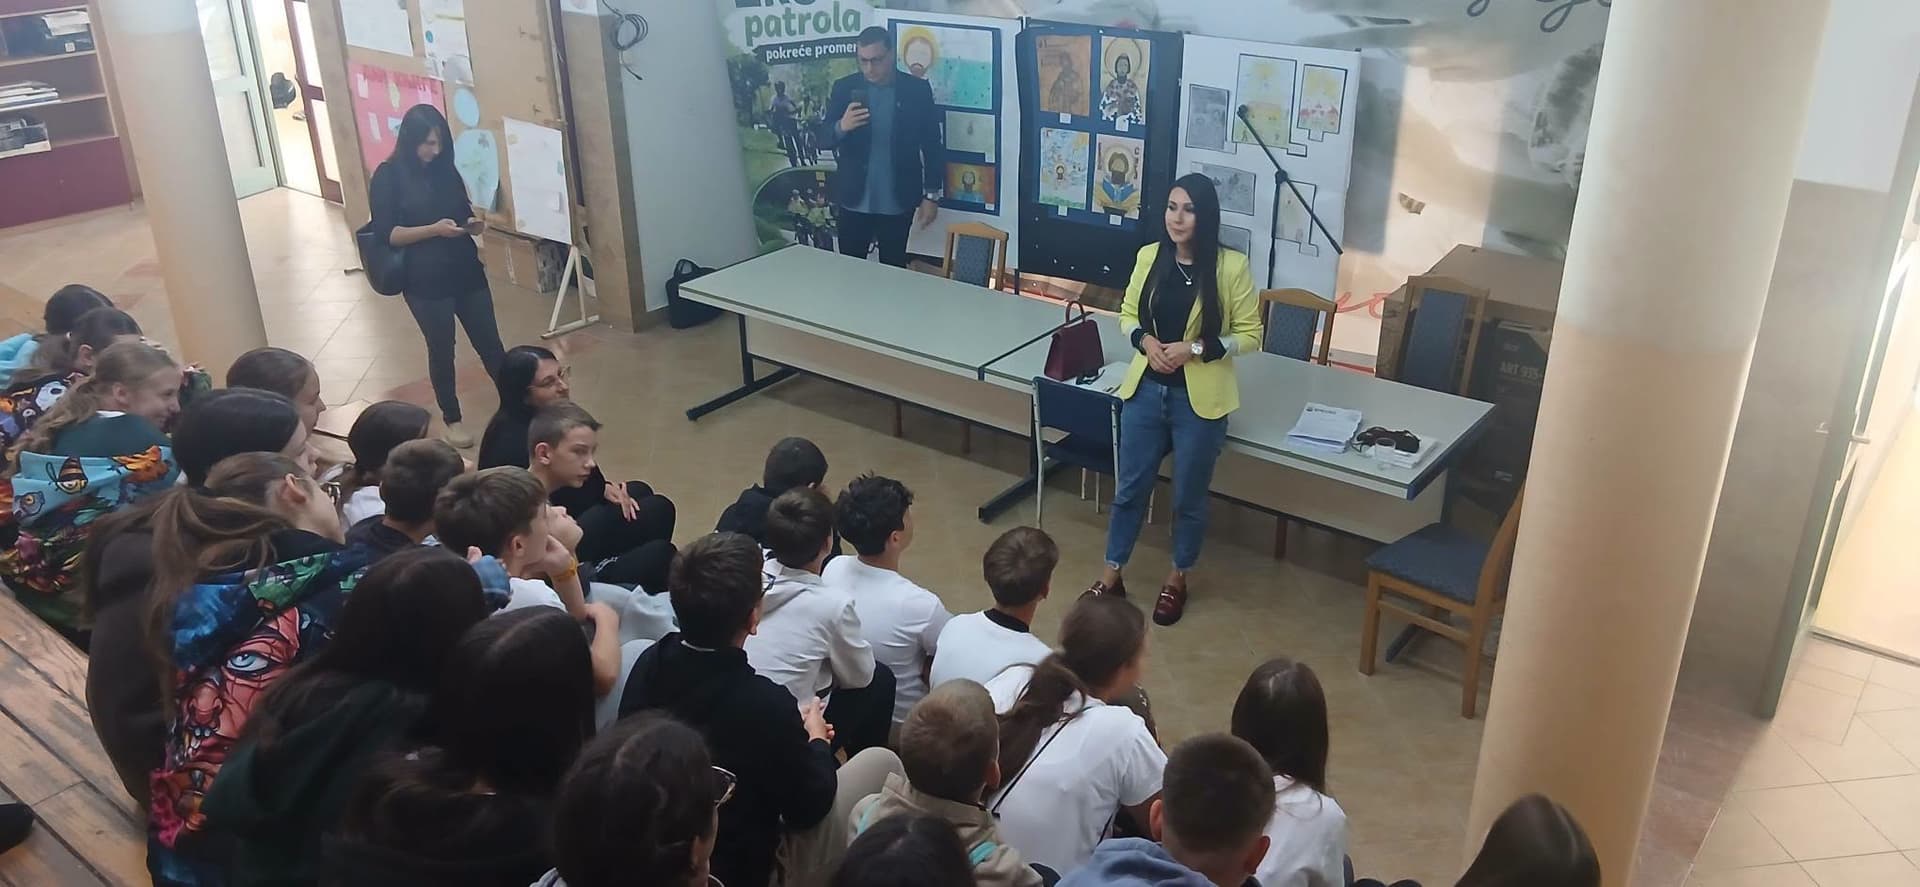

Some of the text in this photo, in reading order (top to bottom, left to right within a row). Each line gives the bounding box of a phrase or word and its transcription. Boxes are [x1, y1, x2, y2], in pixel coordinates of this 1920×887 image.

[744, 1, 861, 47] patrola
[766, 44, 812, 62] pokreće
[1499, 361, 1520, 375] ART
